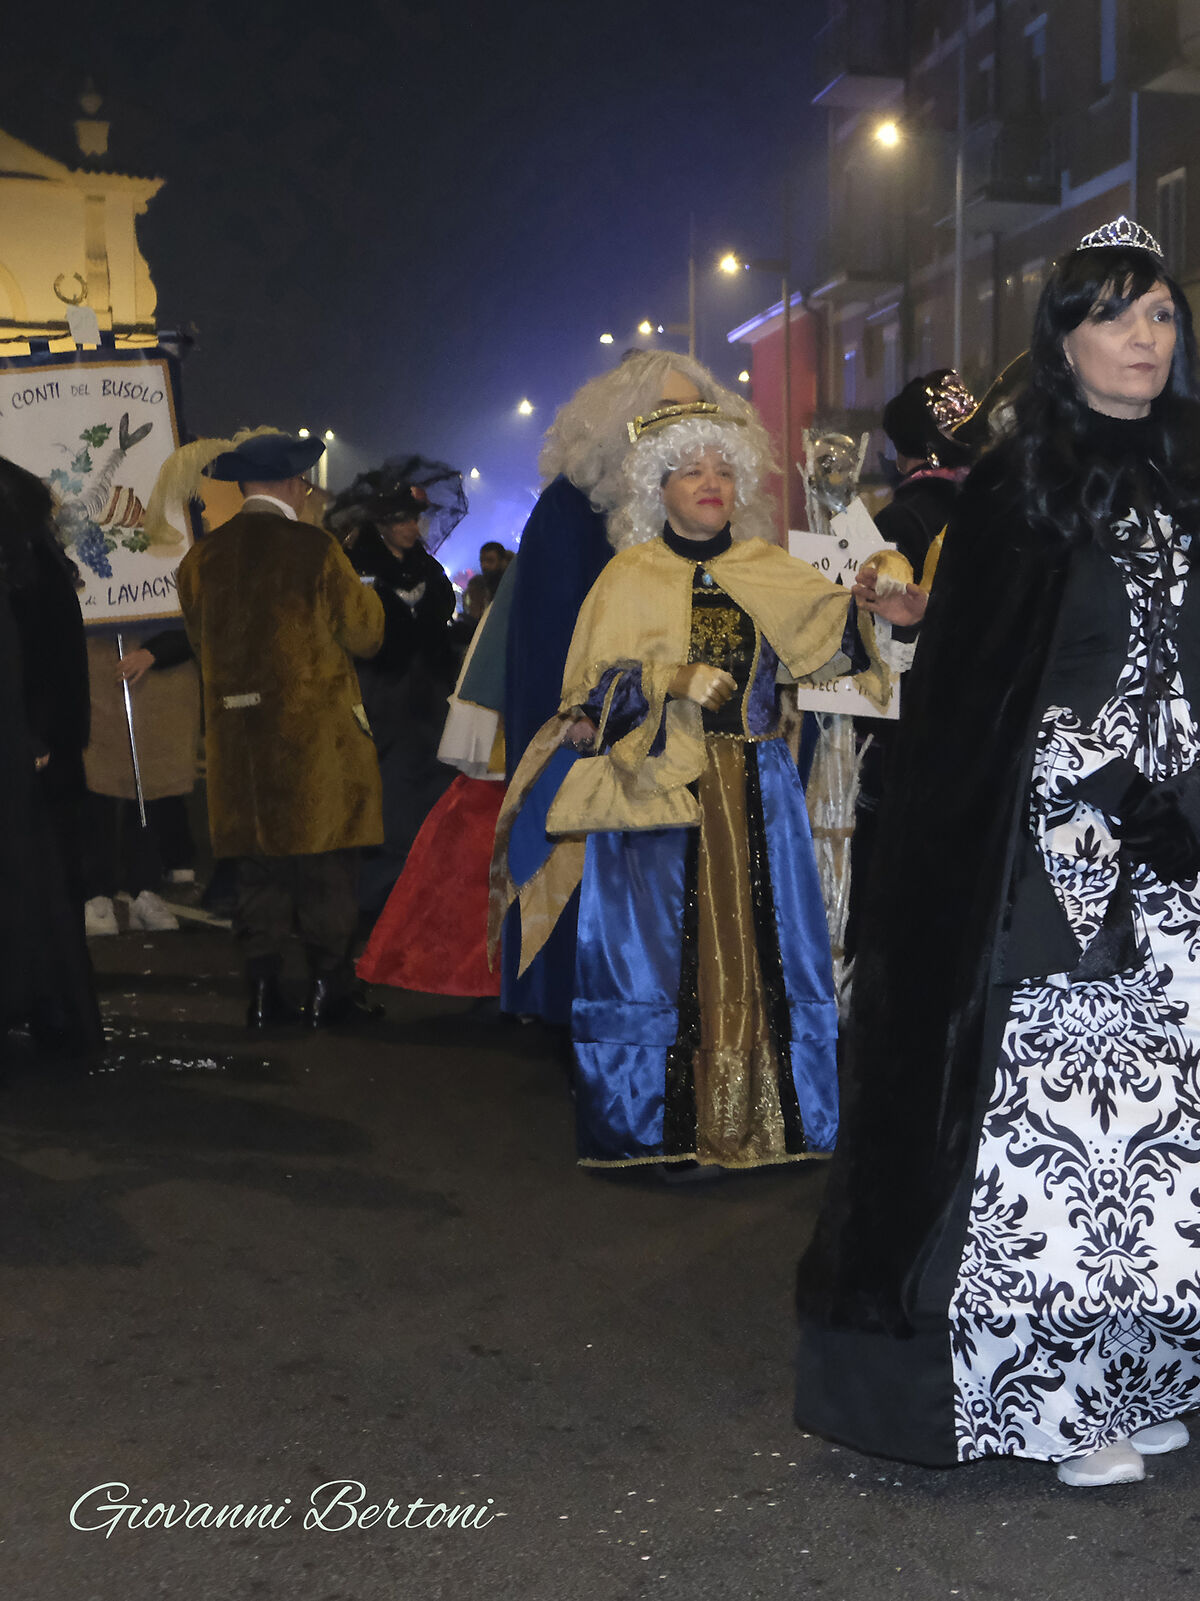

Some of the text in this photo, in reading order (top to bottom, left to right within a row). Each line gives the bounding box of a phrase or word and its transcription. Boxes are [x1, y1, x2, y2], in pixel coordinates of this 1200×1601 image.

[11, 379, 163, 409] CONTI DEL BUSOLO
[108, 571, 177, 605] LAVAGN
